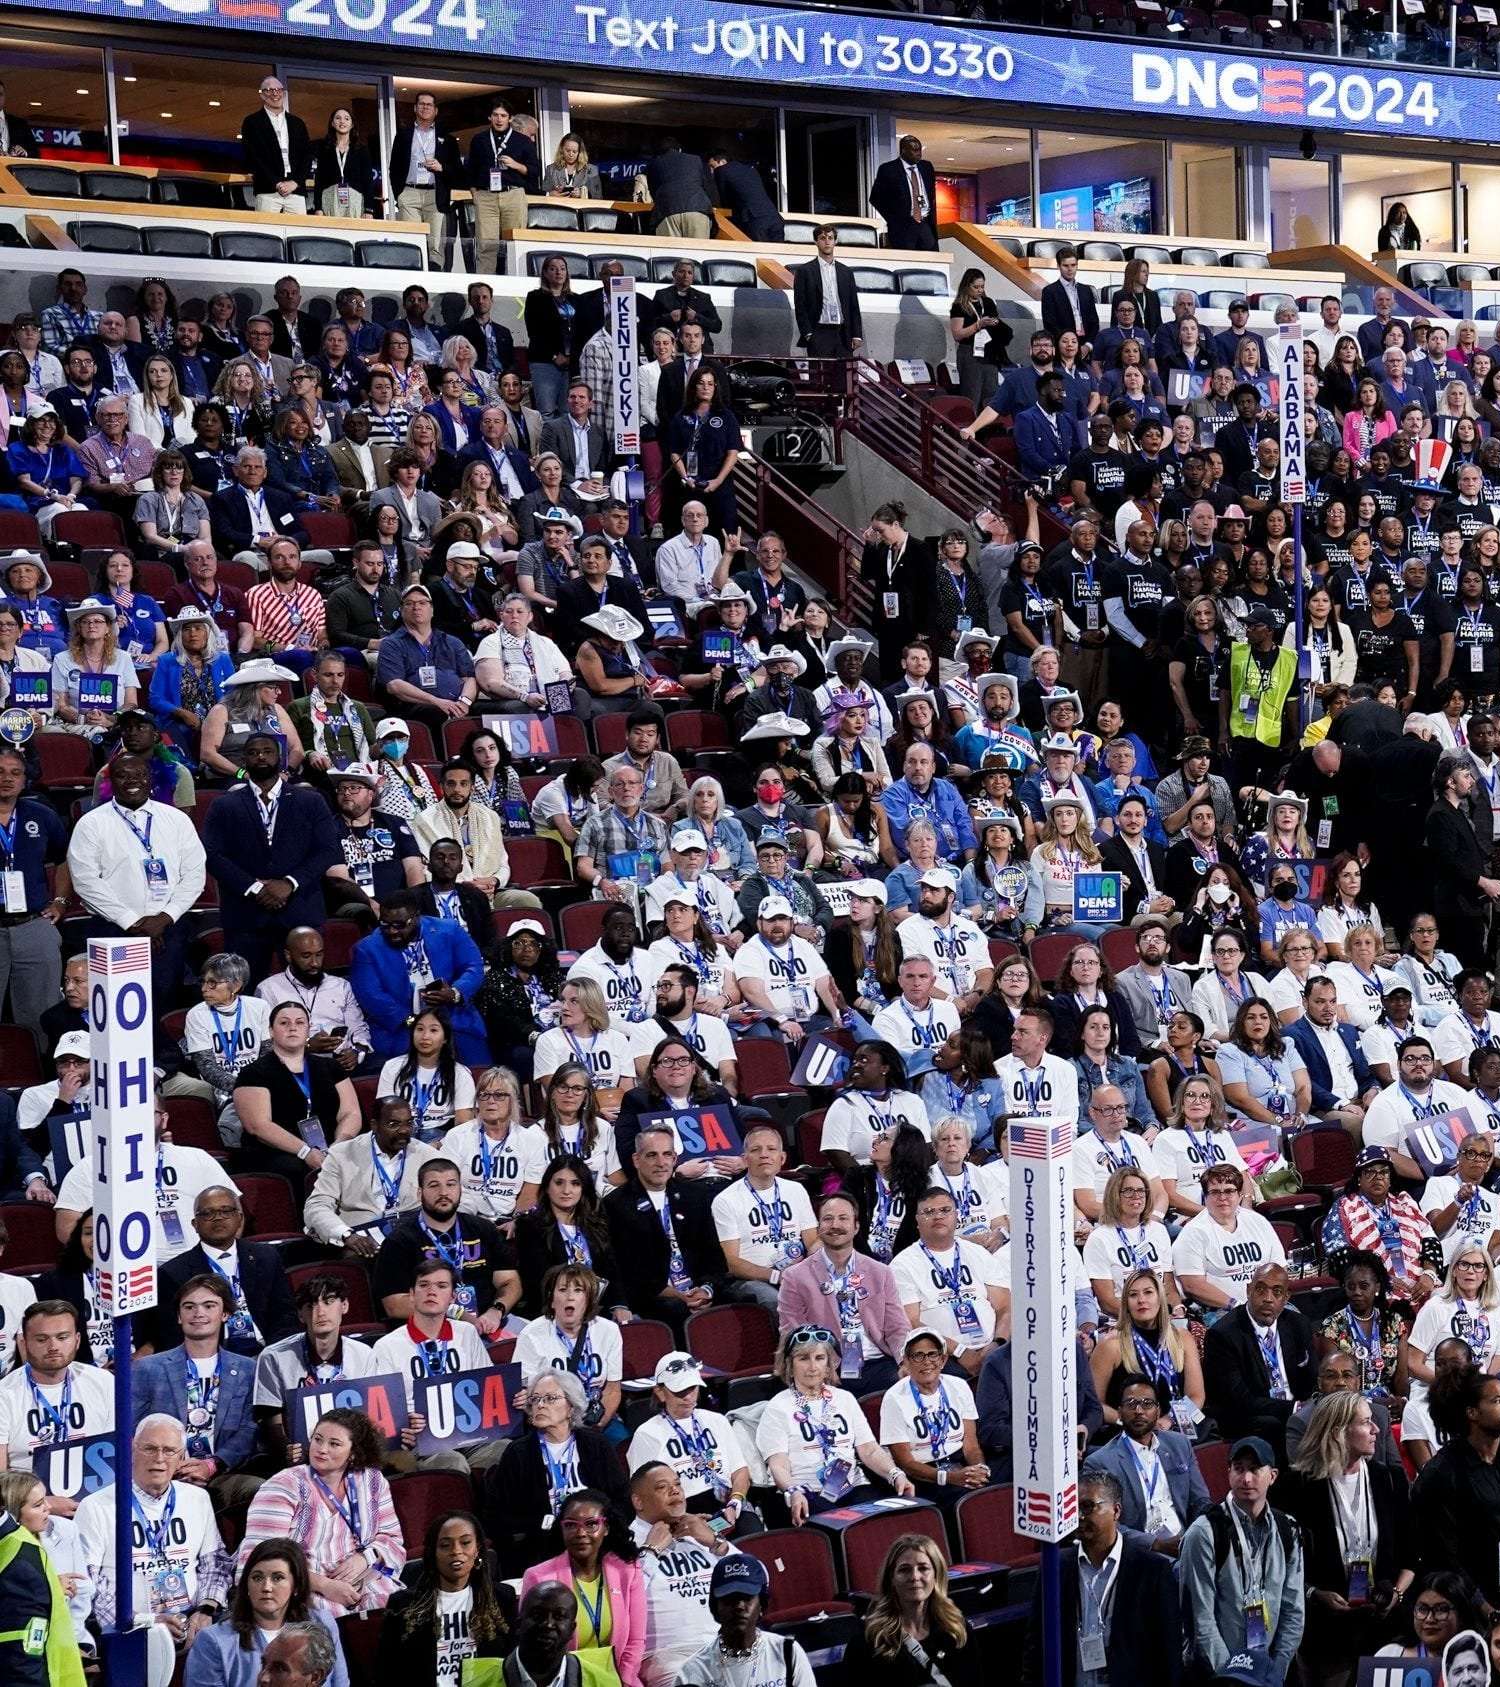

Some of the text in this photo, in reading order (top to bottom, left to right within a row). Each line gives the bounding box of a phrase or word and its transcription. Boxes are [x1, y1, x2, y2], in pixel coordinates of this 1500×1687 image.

[575, 5, 1014, 82] Text JOIN to 30330
[1307, 71, 1440, 126] 2024
[616, 296, 633, 427] KENTUCKY
[1283, 344, 1301, 477] ALABAMA
[1098, 476, 1125, 484] HARRIS
[1133, 592, 1163, 601] HARRIS
[704, 649, 732, 658] DEMS
[15, 693, 48, 702] DEMS
[80, 694, 113, 704] DEMS
[1, 715, 32, 725] HARRIS
[8, 723, 27, 731] WALZ
[997, 873, 1024, 882] HARRIS
[1079, 877, 1117, 896] WA
[1294, 864, 1326, 900] SA
[1079, 897, 1117, 908] DEMS
[934, 939, 967, 958] OO
[92, 983, 111, 1263] OHIO
[115, 980, 152, 1261] OHIO
[652, 1113, 732, 1156] USA
[1186, 1144, 1226, 1164] OHO
[749, 1200, 793, 1228] OHO
[1116, 1242, 1158, 1267] OO
[1222, 1241, 1262, 1267] OHIO
[118, 1270, 128, 1310] DNC
[931, 1264, 973, 1290] OO
[129, 1294, 154, 1309] 2024
[1024, 1167, 1040, 1481] DISTRICT OF COLUMBIA
[1058, 1165, 1071, 1479] DISTRICT OF COLUMBIA
[410, 1355, 461, 1380] OO
[551, 1353, 603, 1375] OO
[27, 1401, 86, 1437] OO
[426, 1374, 510, 1439] USA
[800, 1413, 848, 1442] OO
[913, 1408, 961, 1439] OO
[665, 1428, 718, 1459] OHO
[49, 1441, 116, 1499] US
[1018, 1489, 1027, 1531] DNC
[132, 1517, 187, 1549] OHO
[1028, 1524, 1052, 1538] 2024
[134, 1558, 190, 1570] HARRIS
[725, 1563, 739, 1572] DC
[449, 1640, 466, 1653] for
